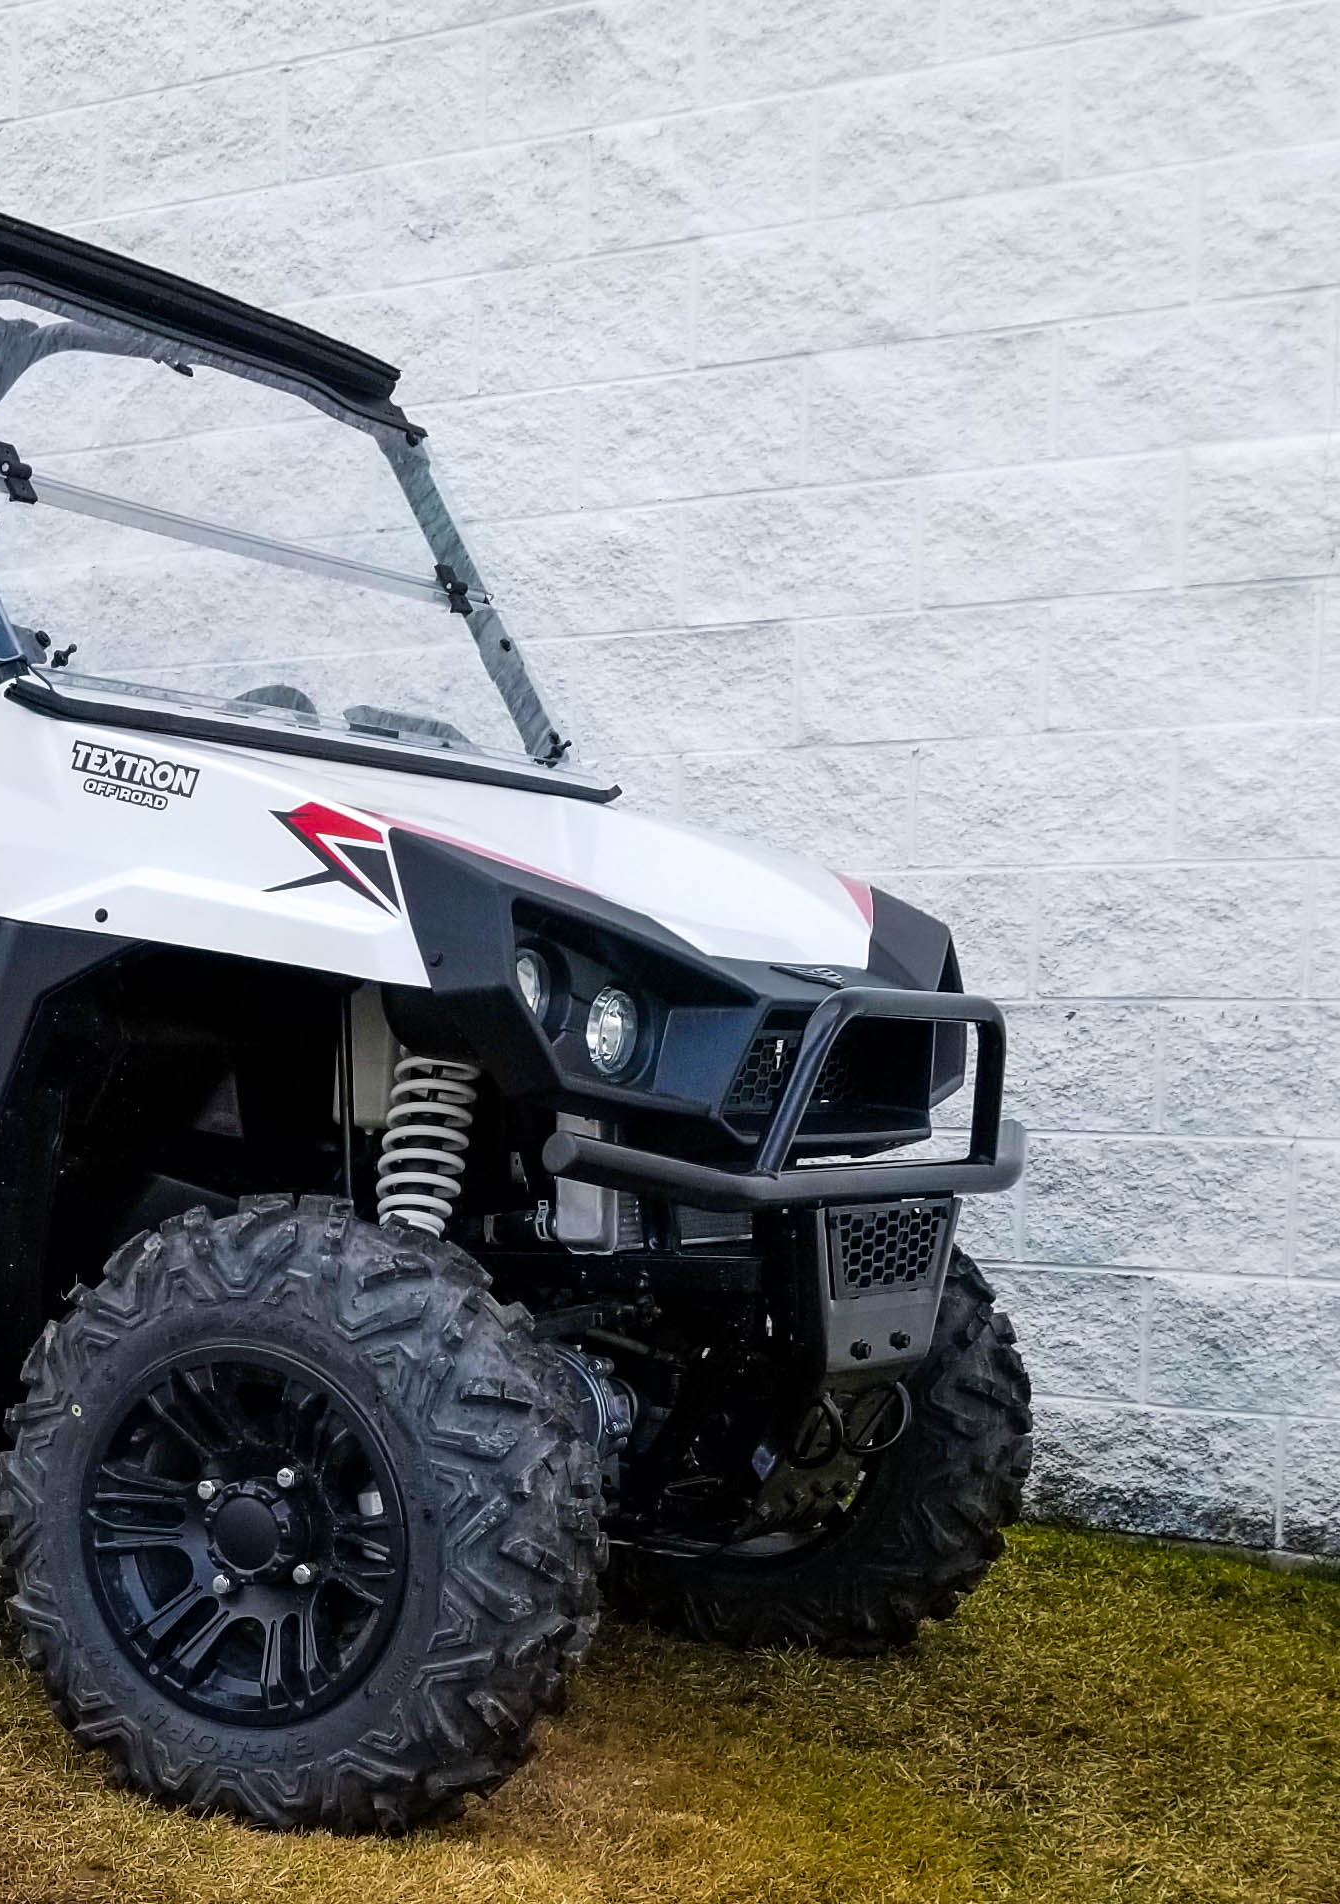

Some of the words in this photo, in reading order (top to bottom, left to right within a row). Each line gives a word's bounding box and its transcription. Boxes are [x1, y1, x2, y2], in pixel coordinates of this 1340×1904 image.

[72, 740, 200, 798] TEXTRON
[84, 778, 117, 798] OFF
[117, 787, 168, 810] ROAD
